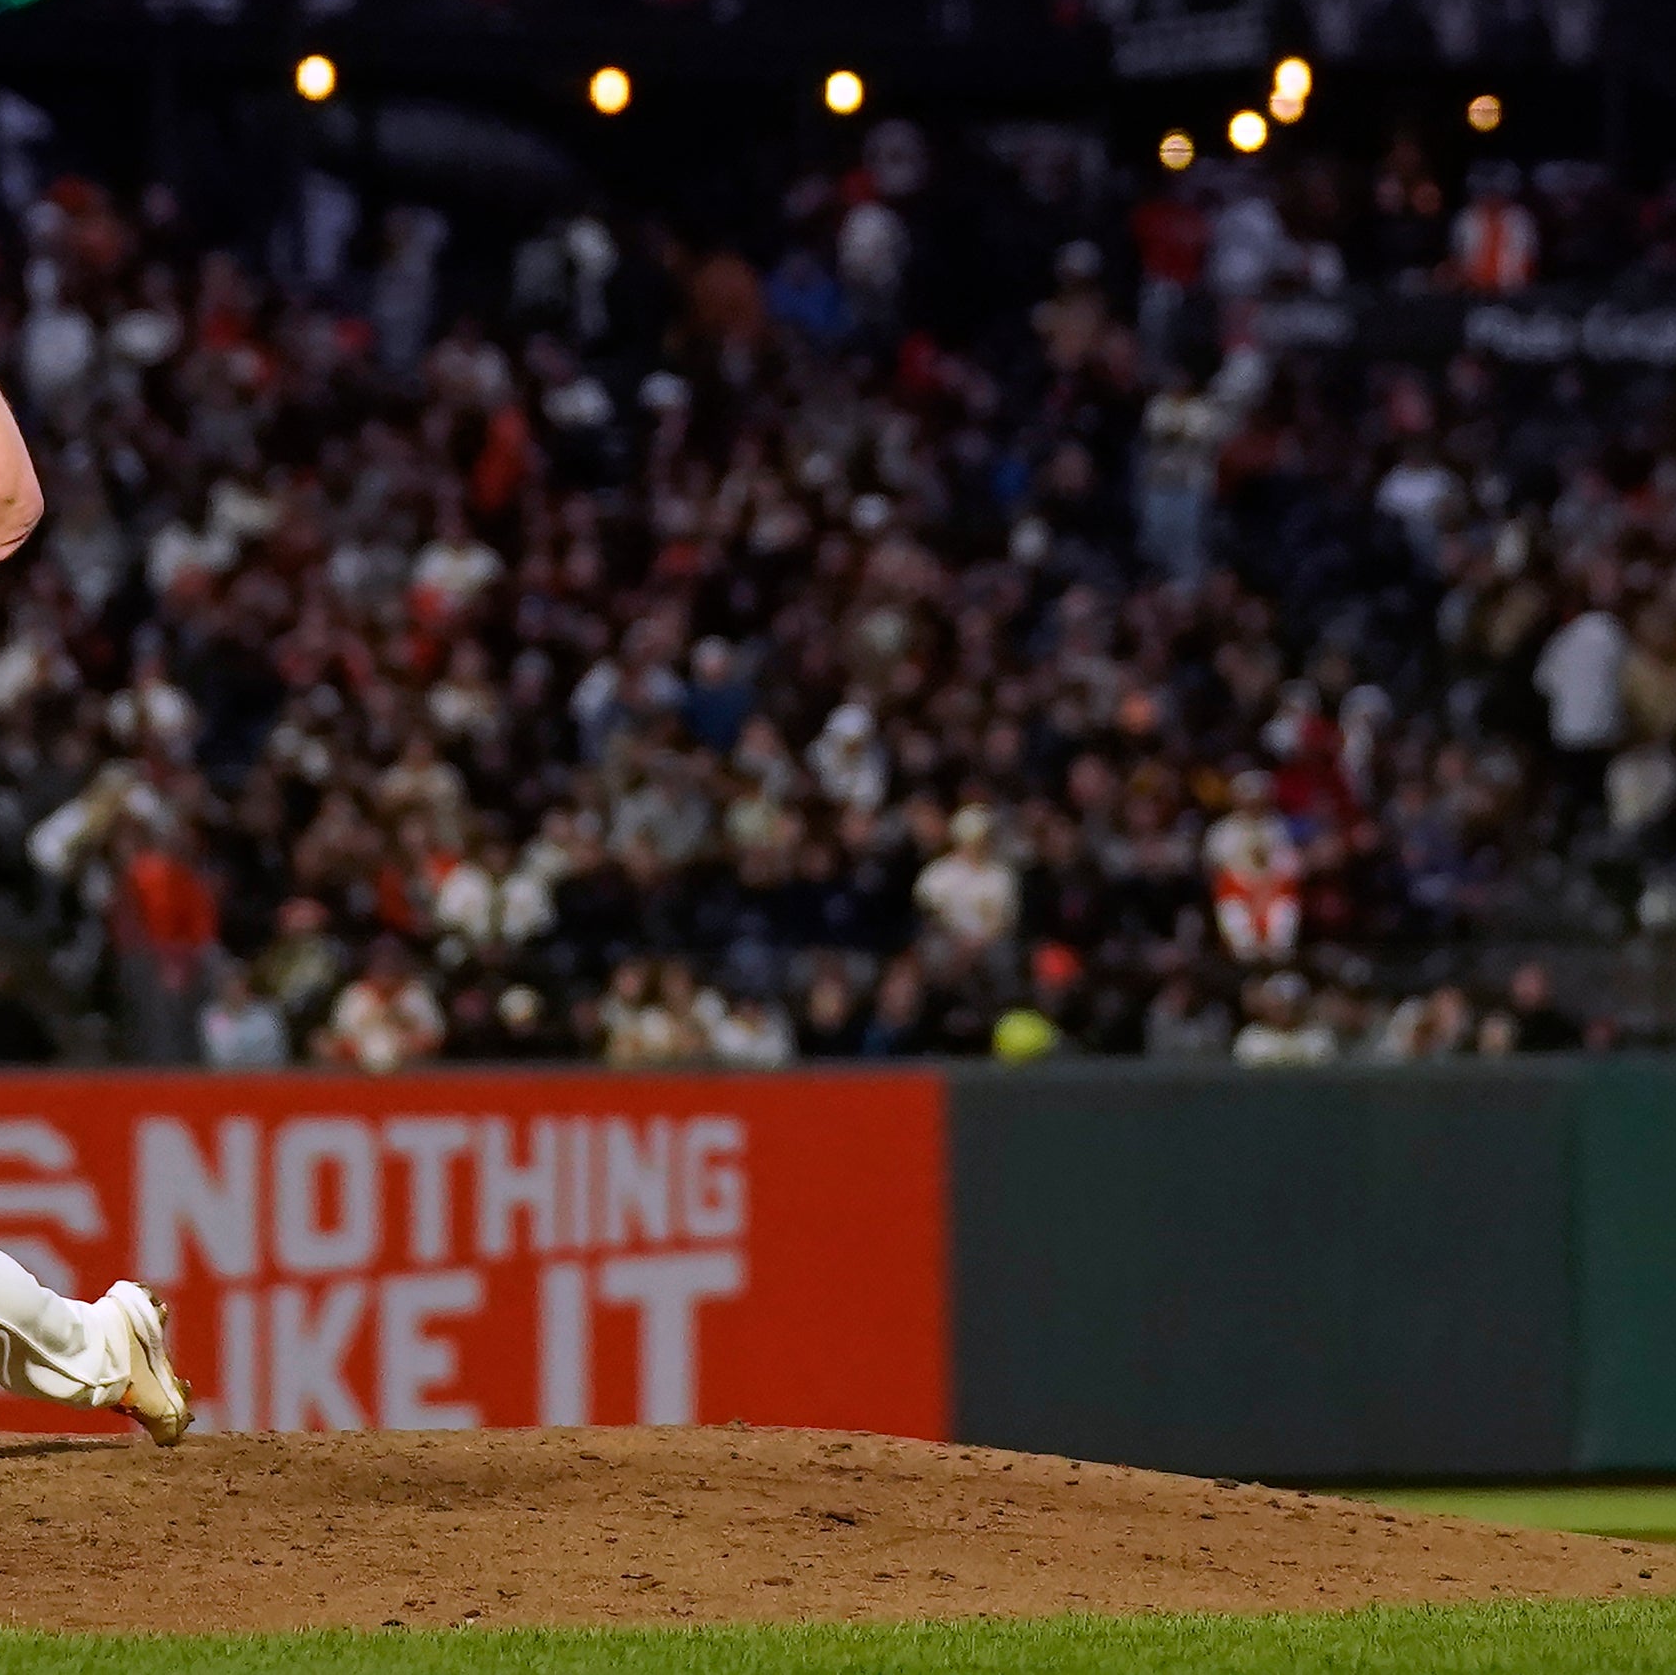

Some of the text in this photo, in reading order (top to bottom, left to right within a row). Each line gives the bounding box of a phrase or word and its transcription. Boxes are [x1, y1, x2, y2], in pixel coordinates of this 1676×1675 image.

[136, 1111, 744, 1284] NOTHING
[189, 1267, 485, 1431] IKE
[538, 1249, 747, 1426] IT
